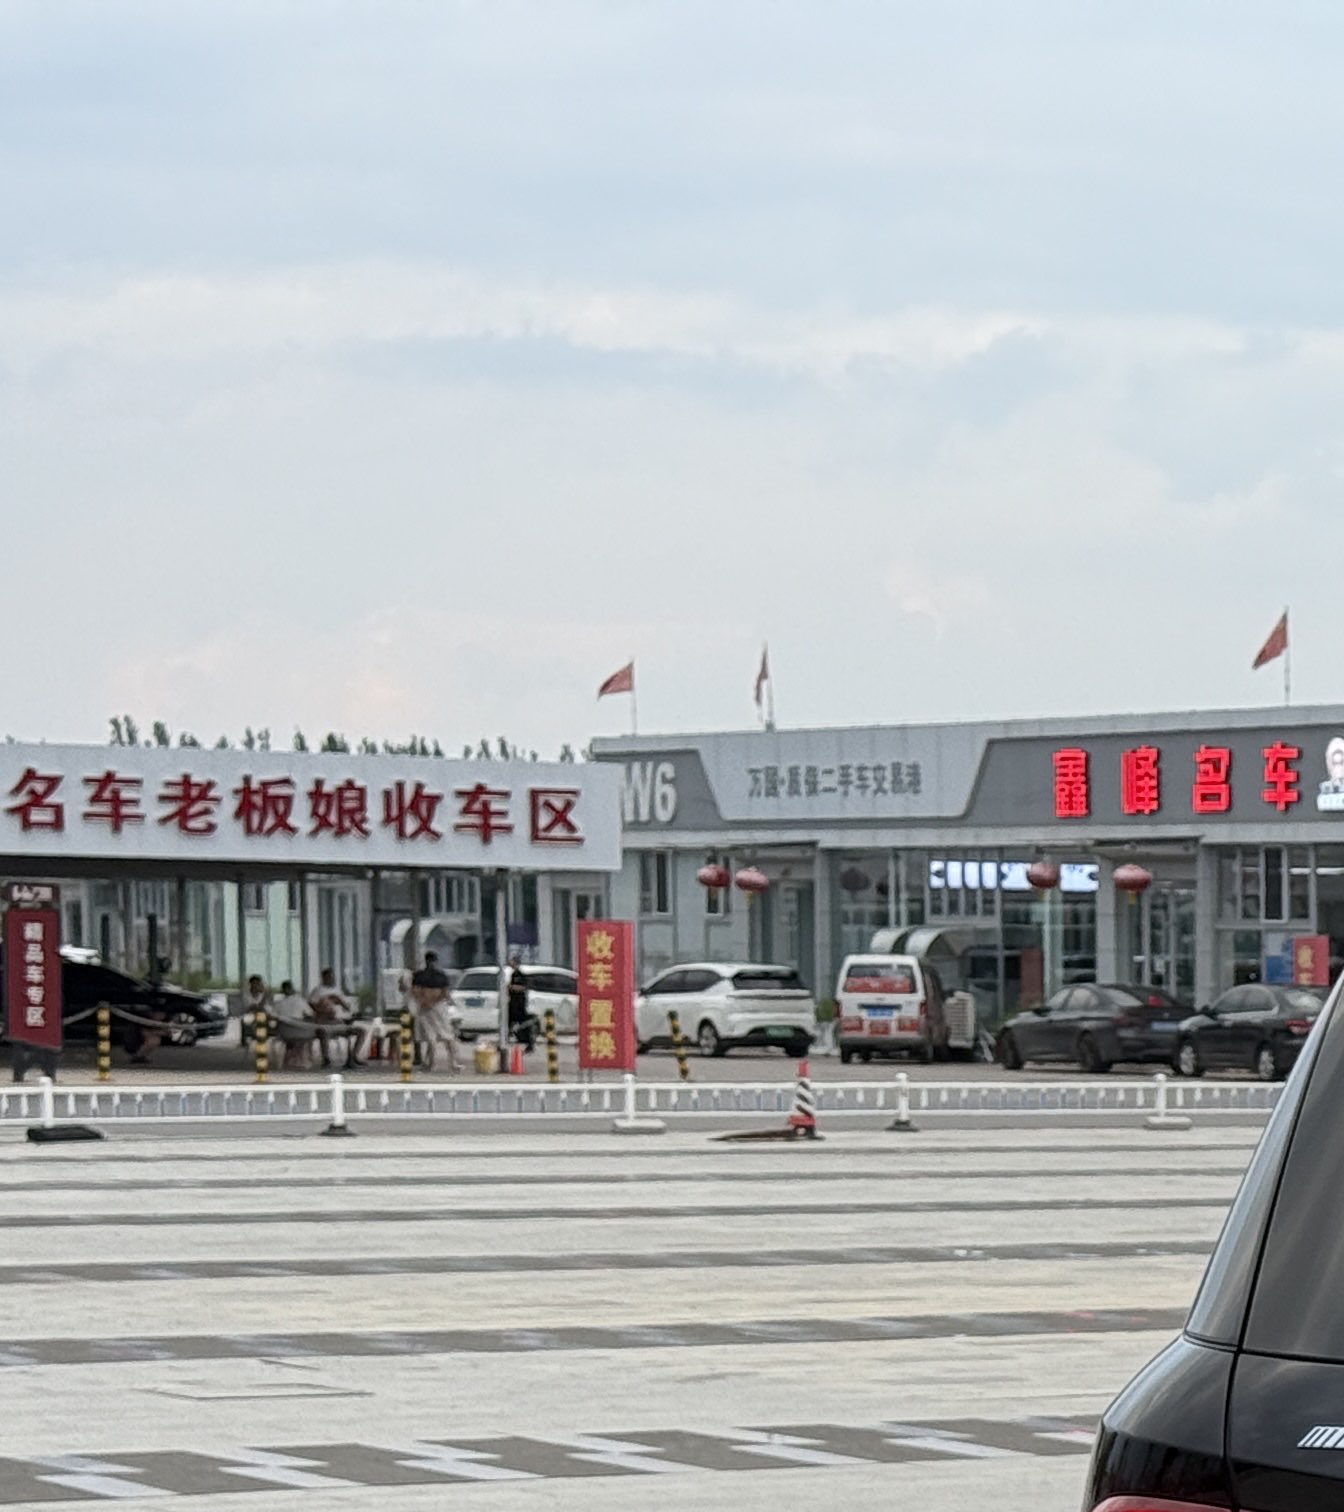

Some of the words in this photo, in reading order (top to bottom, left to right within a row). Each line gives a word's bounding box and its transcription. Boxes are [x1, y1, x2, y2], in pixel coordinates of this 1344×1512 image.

[4, 767, 584, 846] 名车老板娘收车区
[624, 760, 677, 822] W6
[1053, 741, 1300, 817] 鑫峰名车
